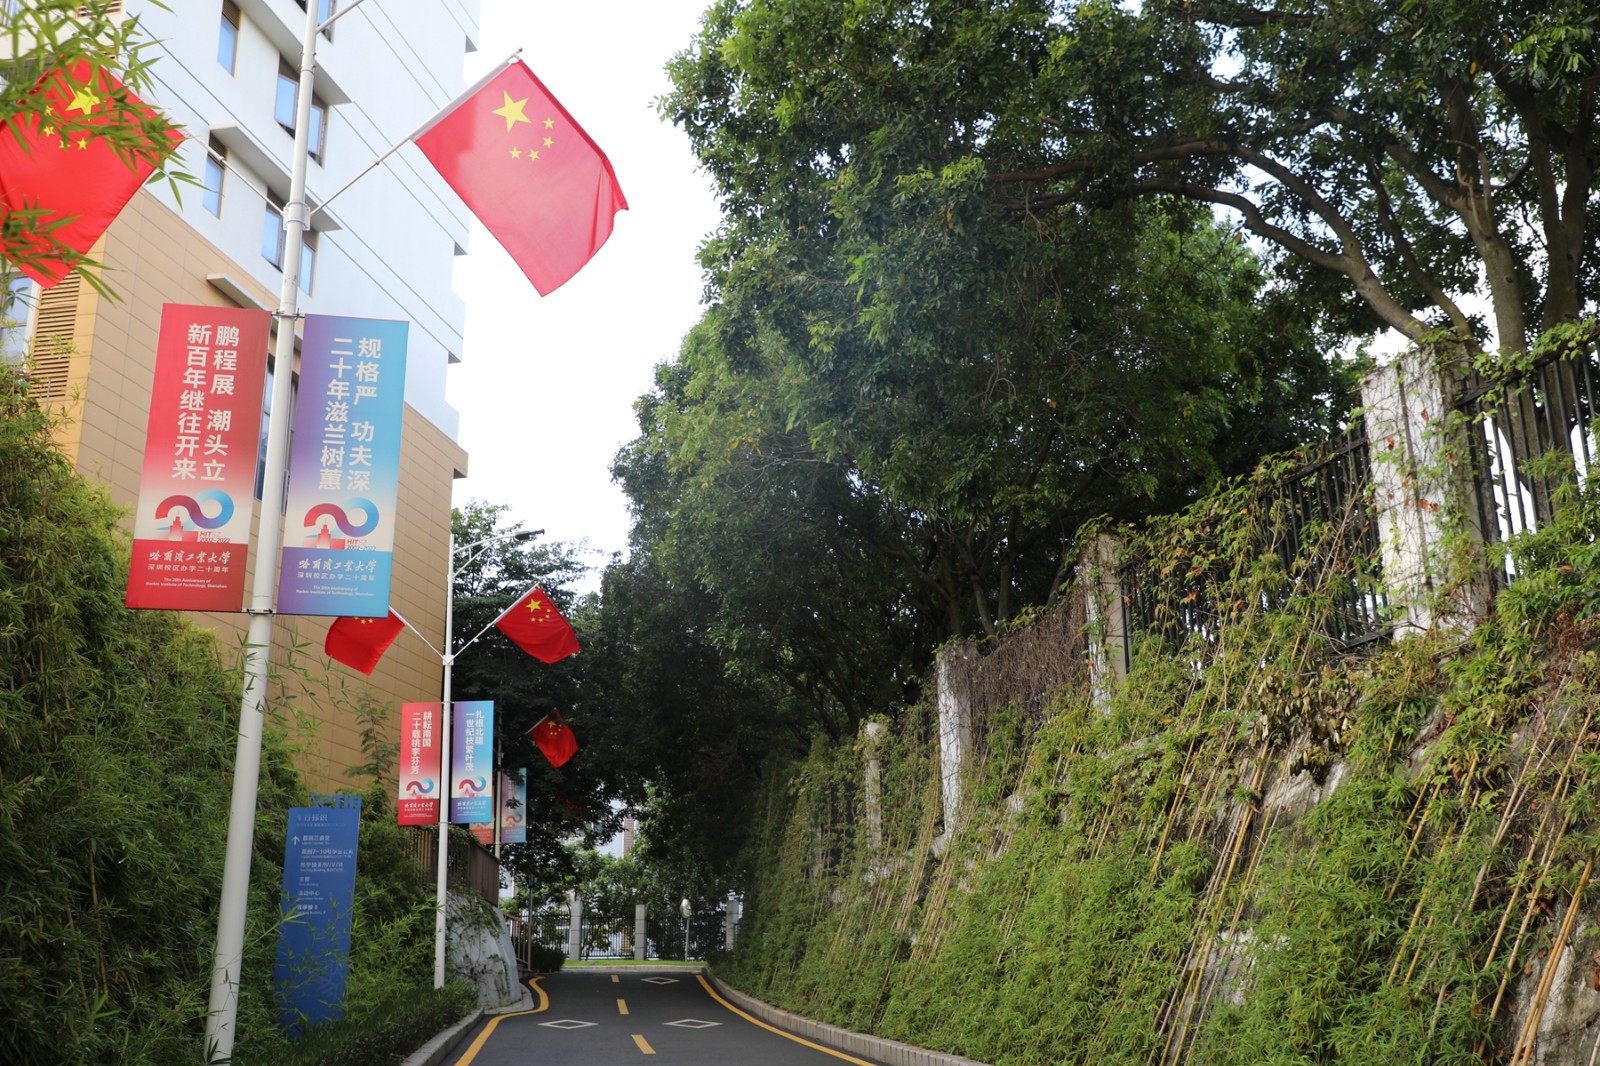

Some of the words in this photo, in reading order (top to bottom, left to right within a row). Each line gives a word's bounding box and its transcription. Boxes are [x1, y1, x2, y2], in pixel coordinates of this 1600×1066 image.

[171, 323, 212, 481] 新百年继往开来
[318, 337, 354, 491] 二十年滋兰树蕙
[147, 563, 229, 573] 深圳校区办学二十周年
[410, 712, 422, 775] 二十载桃李芬芳
